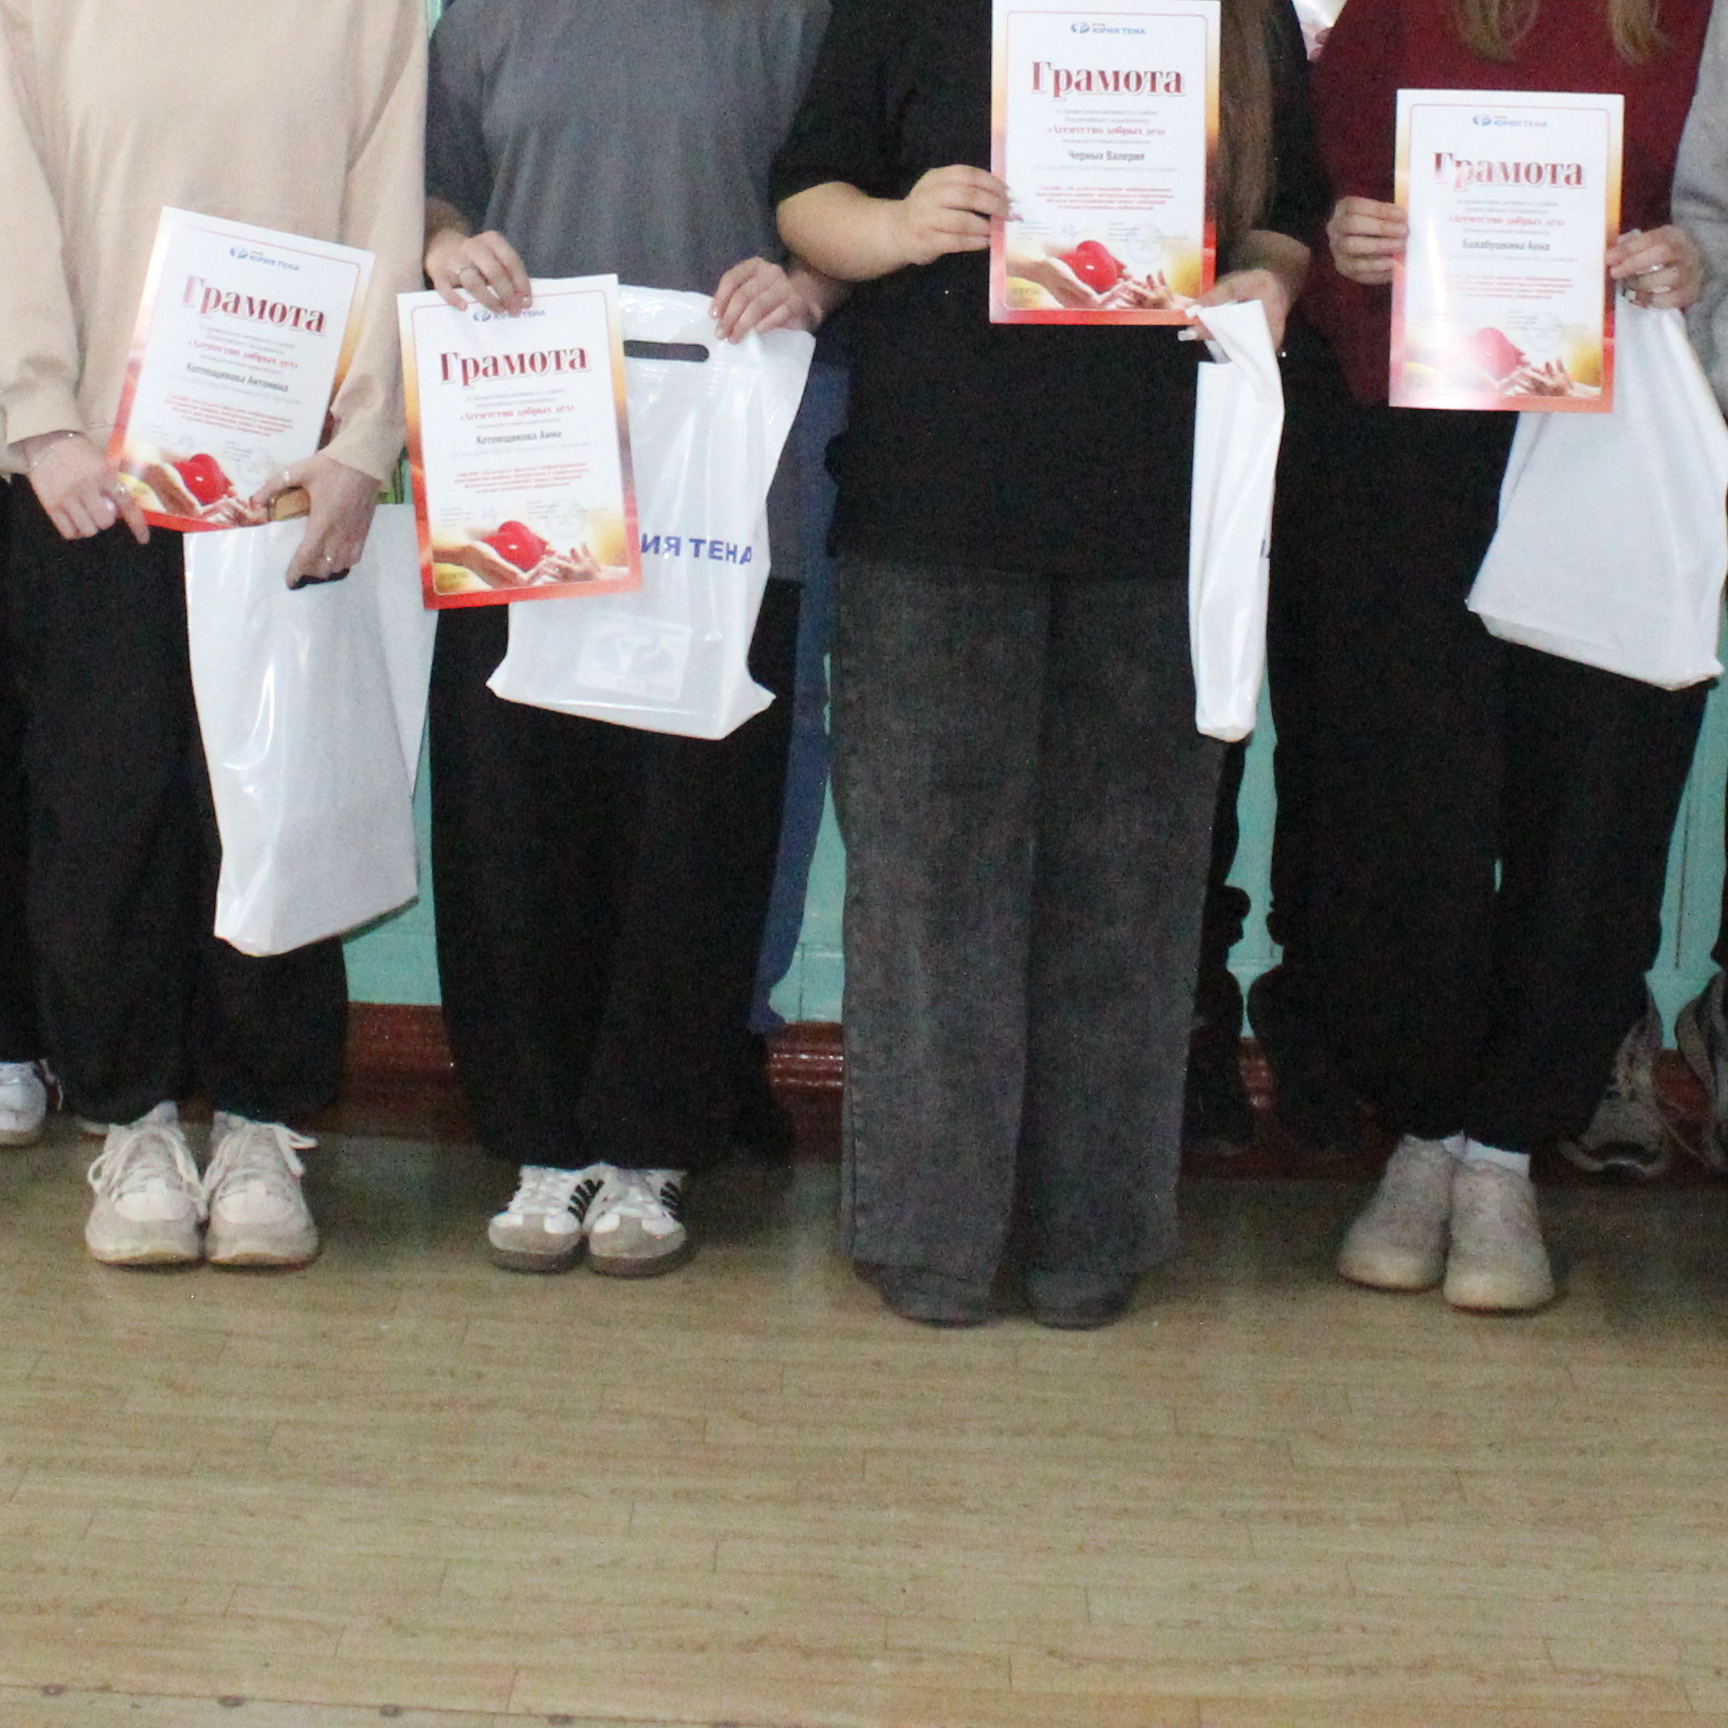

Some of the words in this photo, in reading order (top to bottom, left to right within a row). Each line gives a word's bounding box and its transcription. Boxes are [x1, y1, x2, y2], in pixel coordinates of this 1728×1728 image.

[1032, 60, 1184, 99] Грамота
[1433, 152, 1584, 190] Грамота
[182, 275, 327, 334] Грамота
[439, 346, 589, 387] Грамота
[689, 538, 754, 565] ТЕНА
